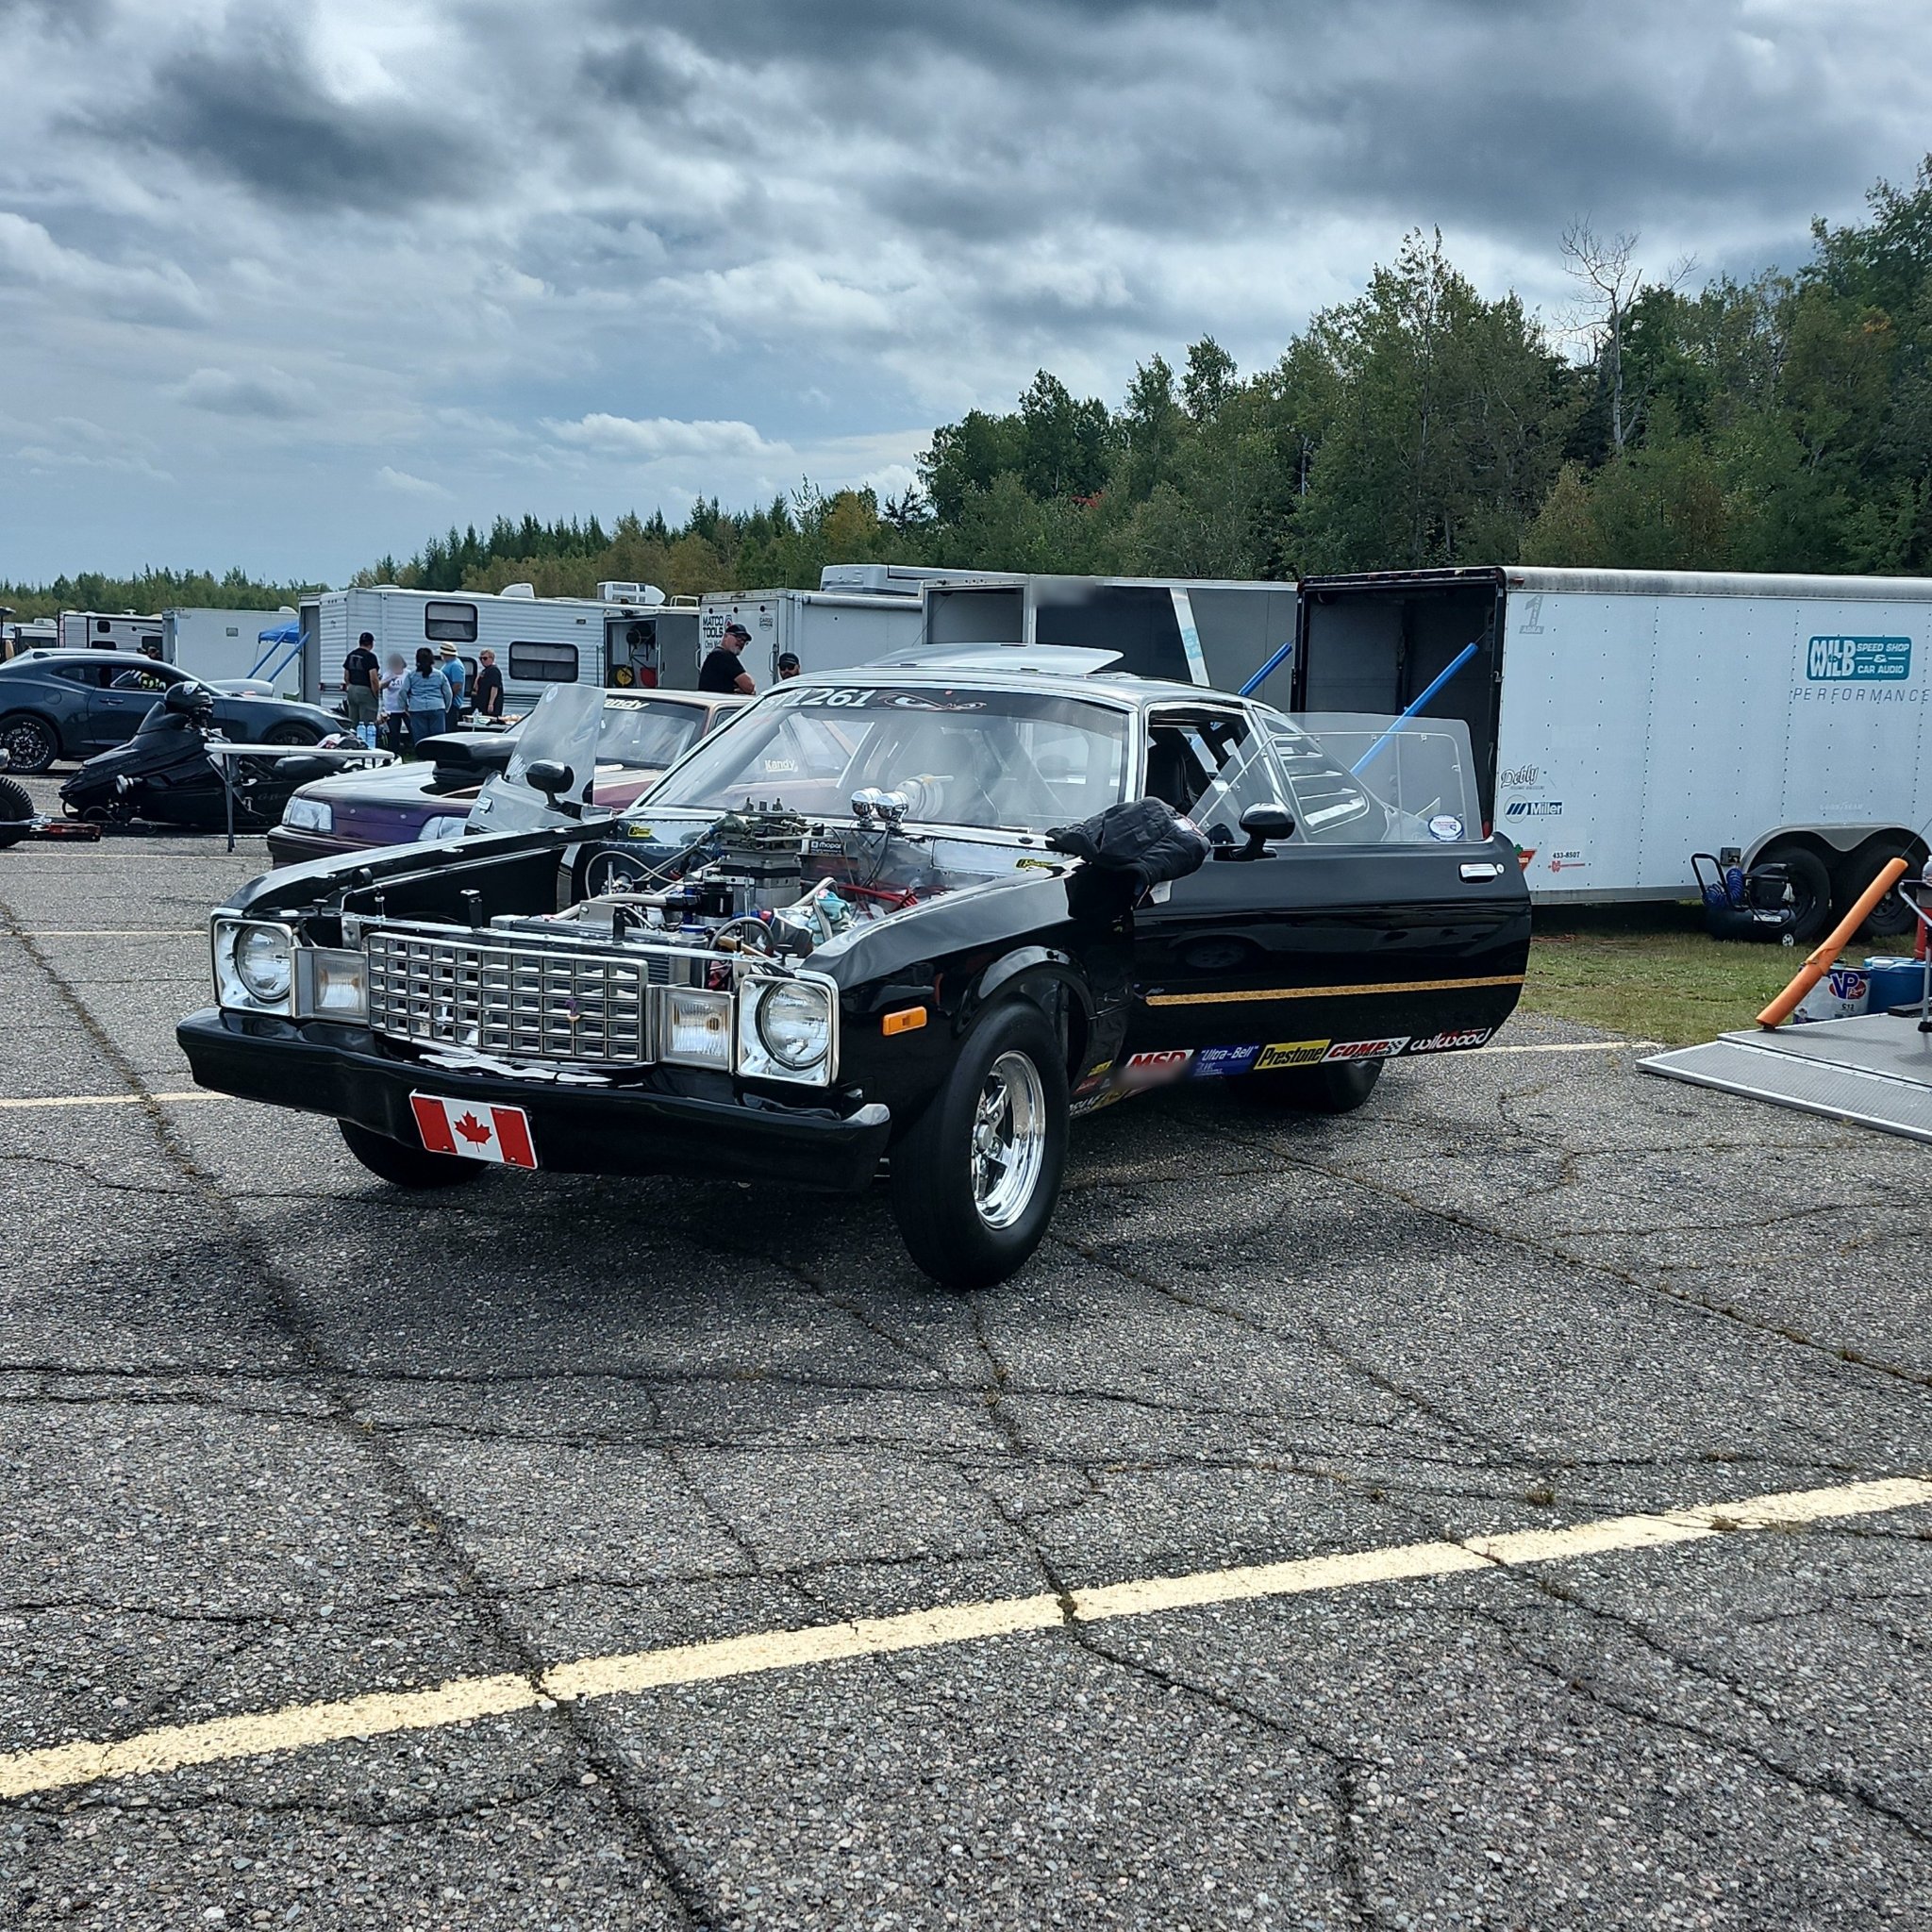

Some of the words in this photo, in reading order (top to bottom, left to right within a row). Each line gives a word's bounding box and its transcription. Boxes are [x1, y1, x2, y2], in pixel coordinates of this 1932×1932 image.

[703, 616, 724, 626] MATCO
[703, 627, 724, 638] TOOLS
[1809, 640, 1857, 659] MILD
[1857, 642, 1884, 652] SPEED
[1886, 643, 1910, 652] SHOP
[1874, 655, 1888, 663] &
[1810, 658, 1856, 677] WILD
[1857, 664, 1876, 674] CAR
[1877, 665, 1904, 674] AUDIO
[782, 688, 878, 708] 1261
[1792, 688, 1931, 702] PERFORMANCE
[1530, 803, 1562, 815] Miller
[1830, 973, 1859, 1000] VP
[1410, 1027, 1492, 1051] wilwood
[1258, 1046, 1322, 1067] Prestone
[1328, 1041, 1390, 1058] COMP
